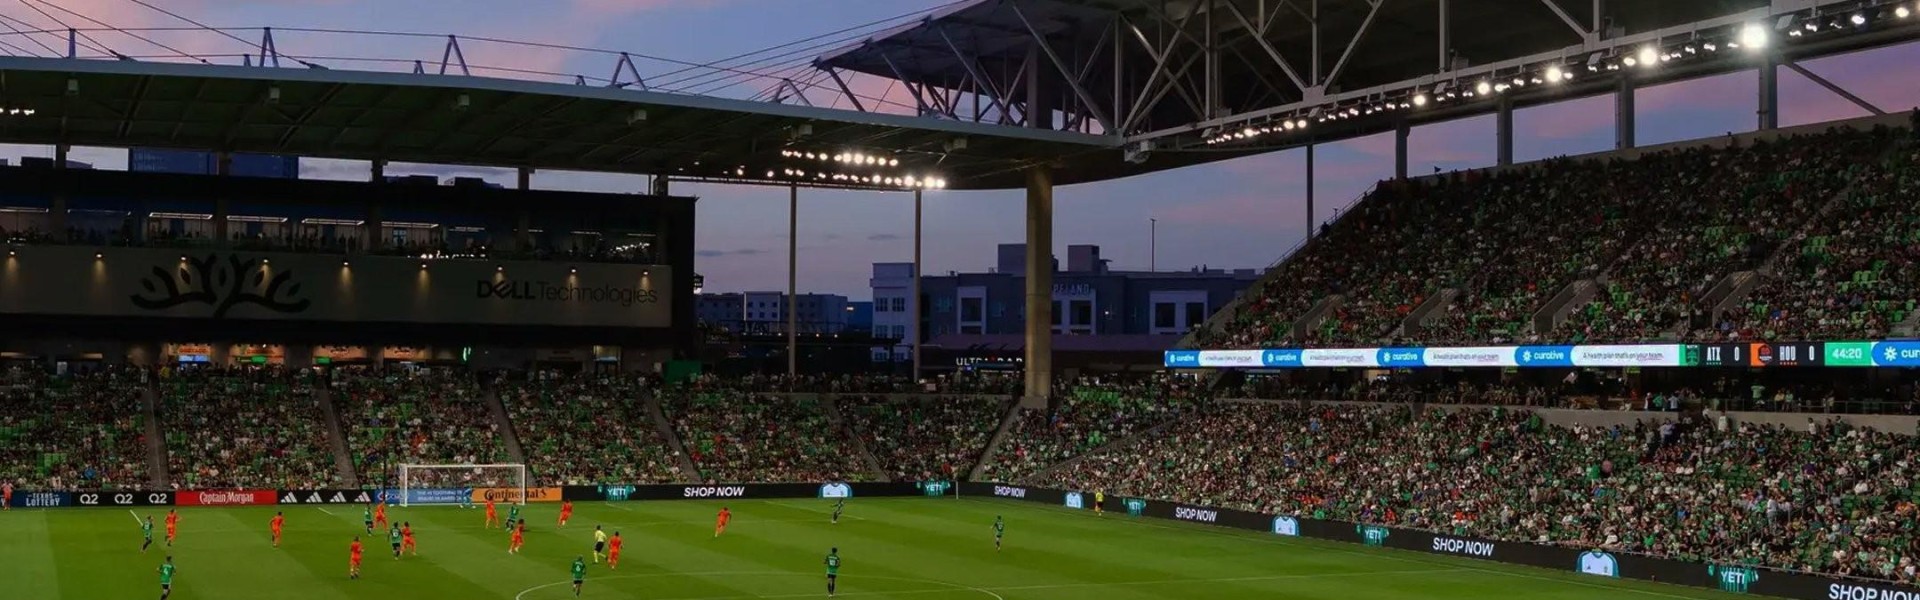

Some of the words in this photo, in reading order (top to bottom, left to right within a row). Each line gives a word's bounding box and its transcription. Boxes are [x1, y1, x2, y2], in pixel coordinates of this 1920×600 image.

[477, 280, 536, 299] DELL
[536, 281, 658, 308] Technologies
[1533, 350, 1564, 360] curative
[1706, 346, 1721, 361] ATX
[1734, 346, 1740, 361] 0
[1779, 346, 1796, 361] HOU
[1808, 345, 1815, 361] 0
[1832, 348, 1863, 360] 44:20
[607, 488, 627, 496] YETI
[684, 487, 715, 497] SHOP
[717, 487, 745, 496] NOW
[994, 485, 1011, 496] SHOP
[1011, 488, 1026, 498] NOW
[26, 498, 60, 506] LOTTERY
[80, 494, 99, 504] Q2
[114, 493, 133, 504] Q2
[149, 493, 168, 504] Q2
[199, 492, 227, 504] Captain
[227, 492, 254, 504] Morgan
[1175, 507, 1197, 520] SHOP
[1197, 509, 1218, 522] NOW
[1364, 529, 1383, 540] YETI
[1432, 537, 1464, 553] SHOP
[1464, 541, 1495, 557] NOW
[1720, 570, 1746, 586] YETI
[1828, 583, 1878, 600] SHOP
